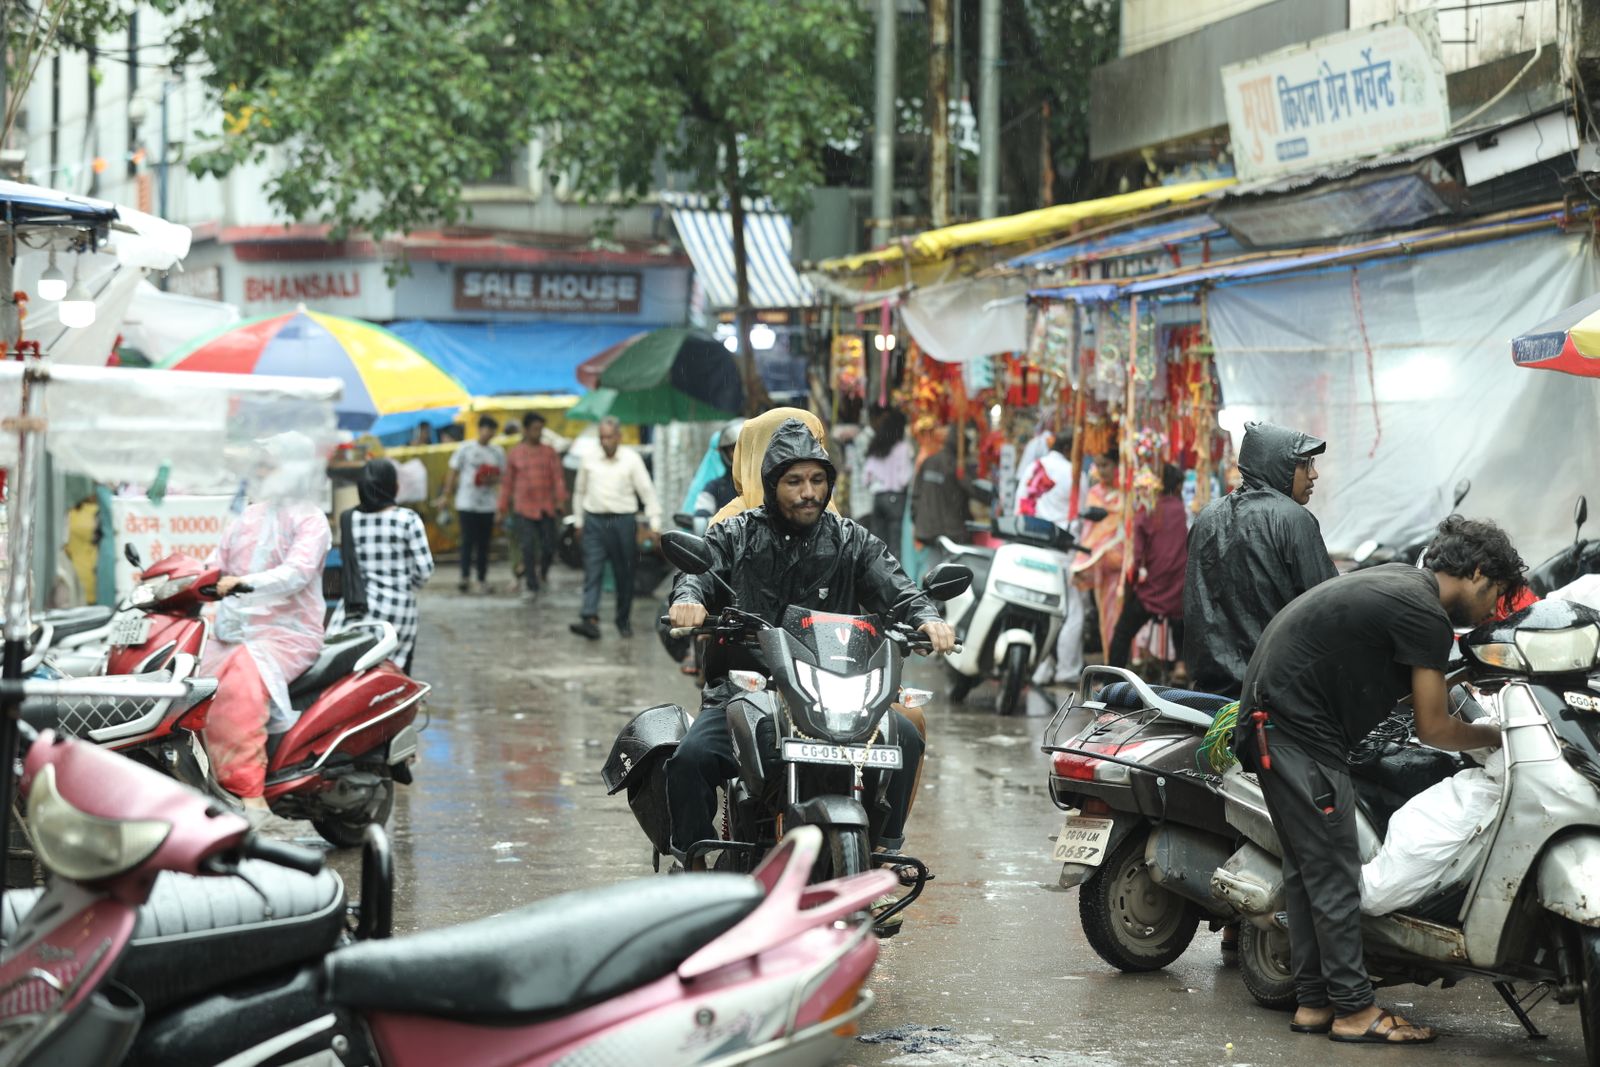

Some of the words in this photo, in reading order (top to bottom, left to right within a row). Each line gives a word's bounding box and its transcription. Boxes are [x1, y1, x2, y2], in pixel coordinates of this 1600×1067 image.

[1277, 74, 1325, 131] किराना
[245, 271, 361, 302] BHANSALI
[463, 271, 533, 297] SALE
[540, 274, 637, 300] HOUSE
[1055, 844, 1100, 860] 0687
